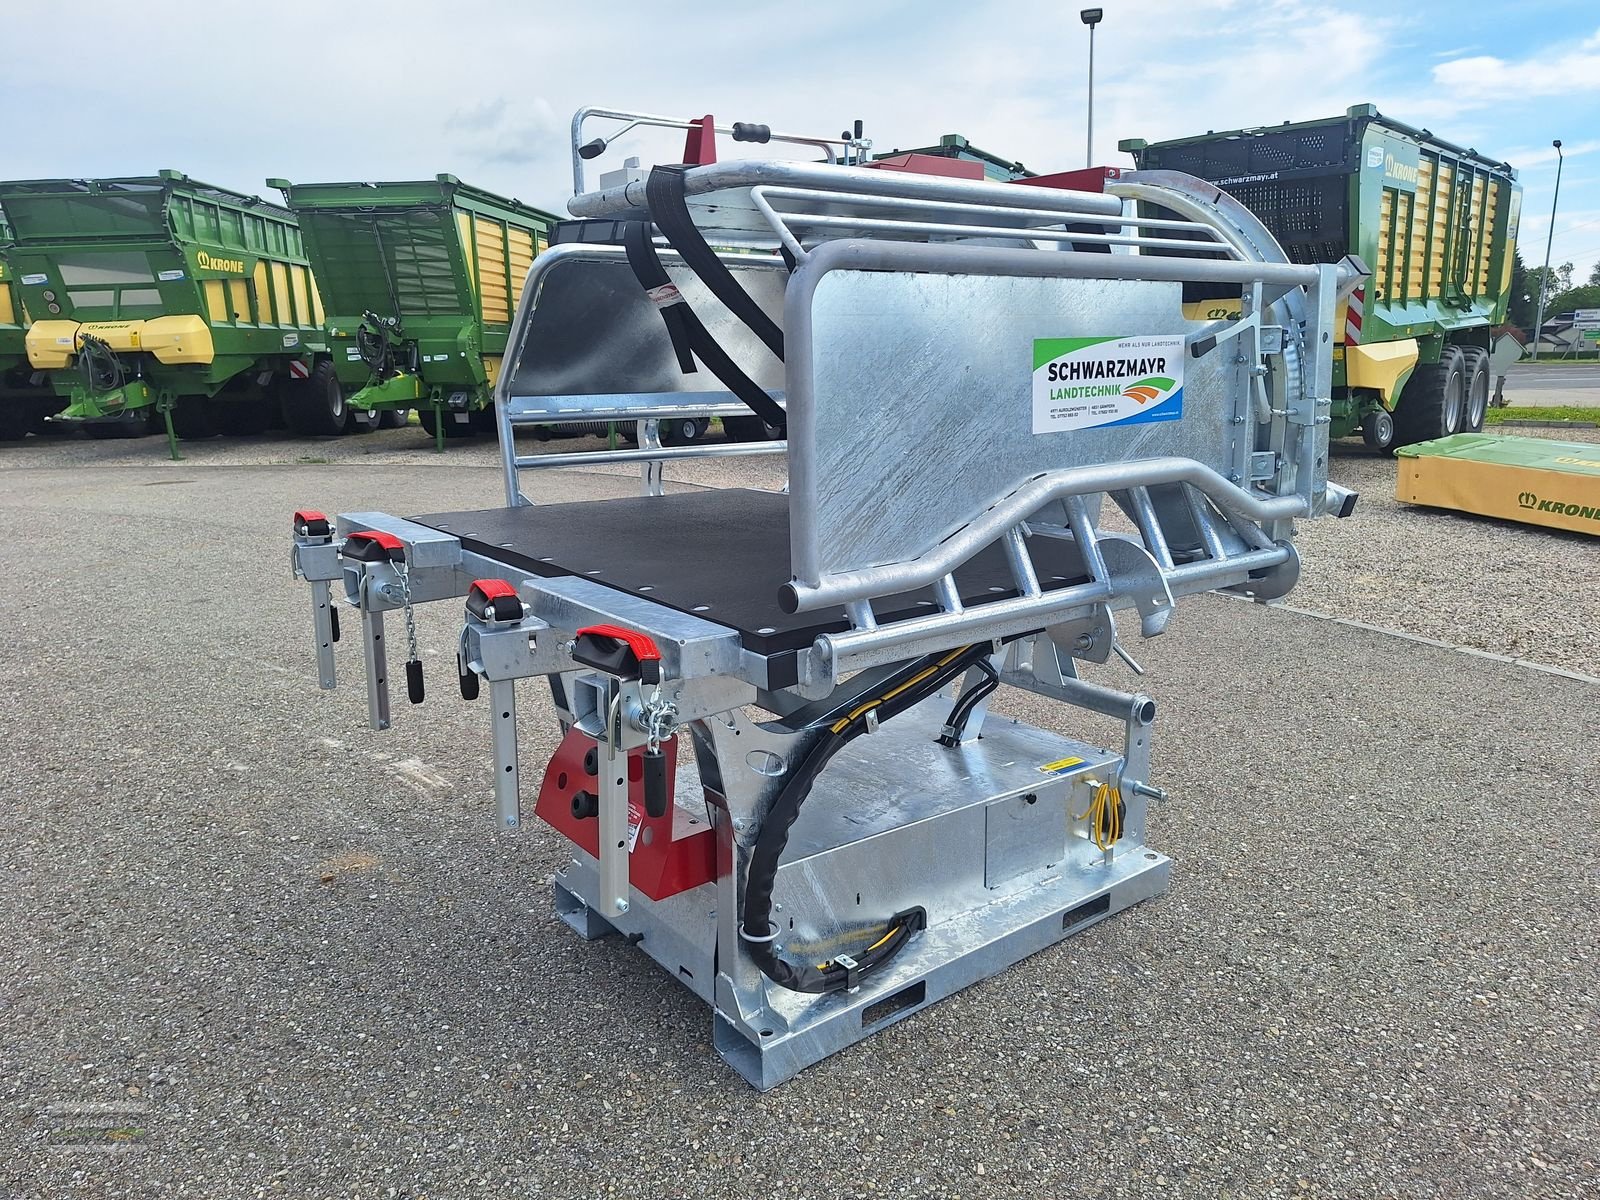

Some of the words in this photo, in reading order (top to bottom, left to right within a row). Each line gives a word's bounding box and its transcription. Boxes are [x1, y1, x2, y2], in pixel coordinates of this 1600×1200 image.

[1392, 161, 1418, 183] KRONE
[210, 257, 244, 273] KRONE
[1048, 357, 1166, 381] SCHWARZMAYR
[1050, 384, 1121, 400] LANDTECHNIK
